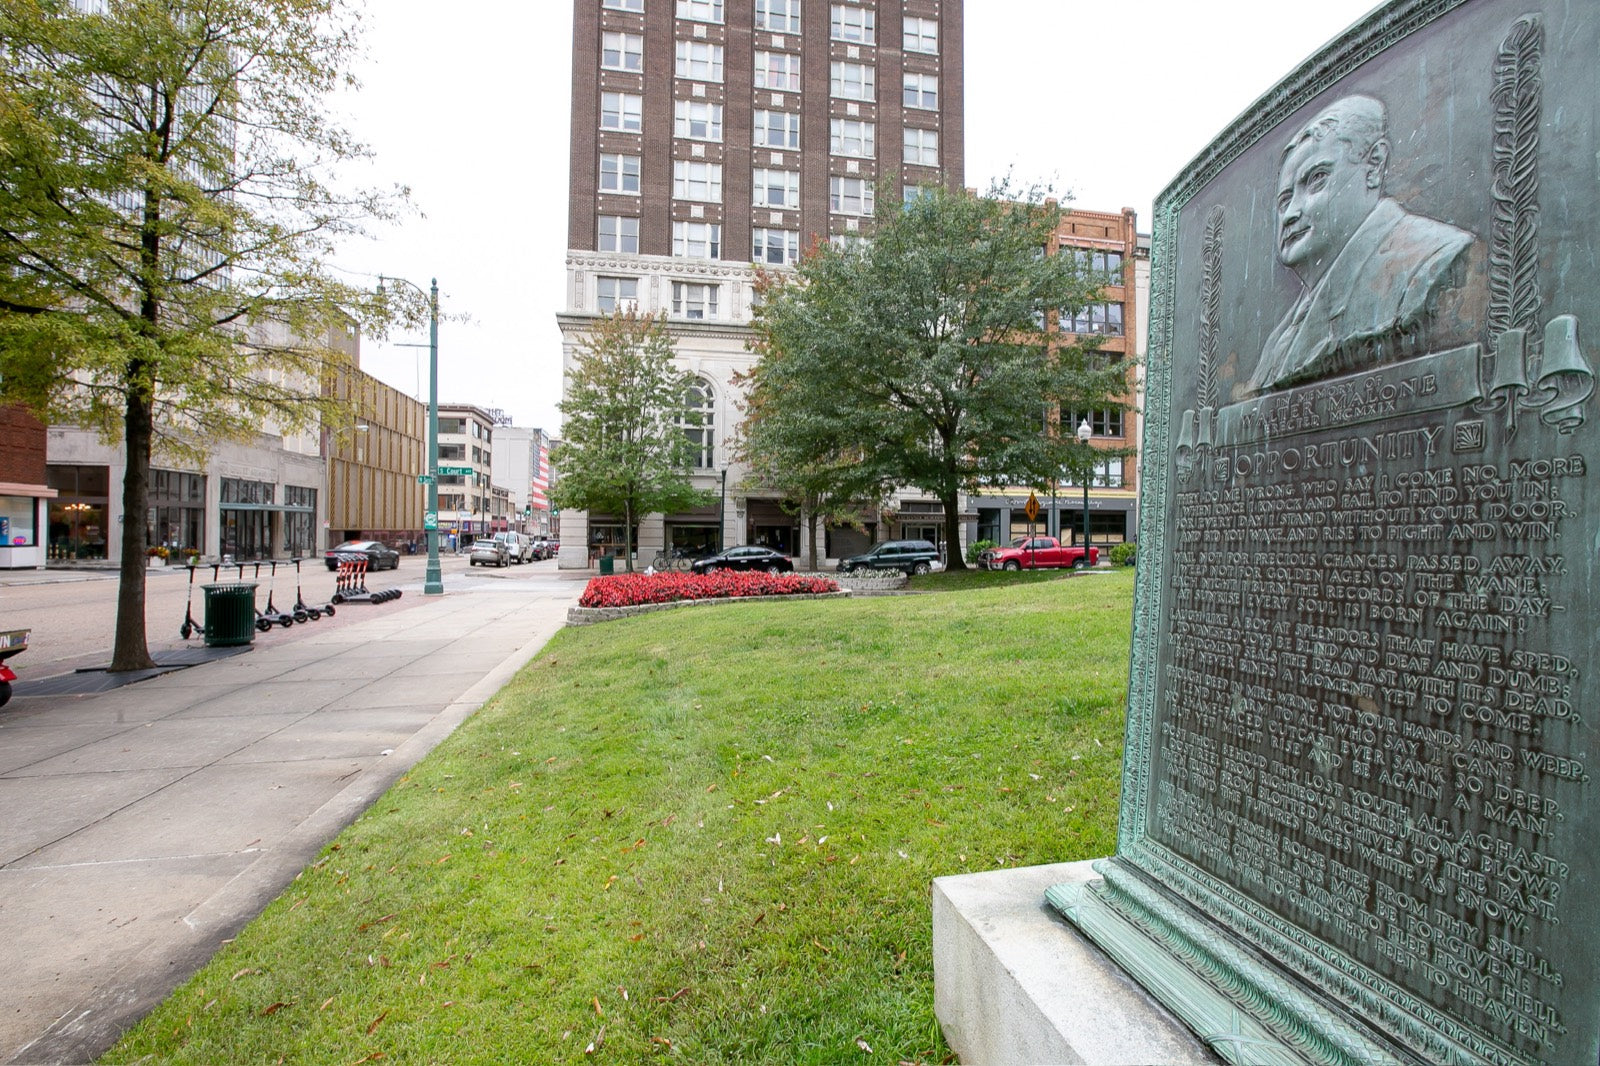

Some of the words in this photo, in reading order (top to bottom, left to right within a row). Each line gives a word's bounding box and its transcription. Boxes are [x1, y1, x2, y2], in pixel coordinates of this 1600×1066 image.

[1276, 395, 1289, 407] IN
[1297, 381, 1354, 402] MEMORY
[1365, 375, 1382, 389] OF
[1327, 374, 1437, 412] MALONE
[1329, 400, 1395, 422] MCMXIX
[446, 467, 463, 475] Court
[1301, 479, 1338, 495] WHO
[1345, 475, 1373, 491] SAY
[1381, 474, 1389, 489] I
[1396, 468, 1453, 487] COME
[1463, 464, 1496, 482] NO
[1509, 456, 1584, 479] MORE
[1279, 511, 1326, 525] STAND
[1331, 508, 1410, 523] WITHOUT
[1418, 504, 1479, 521] YOUR
[1304, 495, 1335, 510] AND
[1343, 492, 1375, 508] FAIL
[1379, 490, 1402, 506] TO
[1409, 486, 1457, 504] FIND
[1463, 482, 1512, 501] YOU
[1286, 527, 1319, 541] AND
[1323, 526, 1354, 540] RISE
[1360, 525, 1382, 540] TO
[1386, 524, 1443, 540] FIGHT
[1448, 522, 1495, 540] AND
[1323, 553, 1397, 569] CHANCES
[1406, 554, 1480, 572] PASSED
[1328, 569, 1371, 585] AGES
[1379, 571, 1405, 587] ON
[1416, 573, 1453, 589] THE
[1292, 582, 1319, 597] THE
[1326, 584, 1403, 604] RECORDS
[1415, 590, 1440, 606] OF
[1450, 592, 1488, 610] THE
[1297, 598, 1338, 615] SOUL
[1344, 602, 1360, 617] IS
[1369, 604, 1422, 624] BORN
[1435, 609, 1526, 635] AGAIN!
[1272, 620, 1290, 635] AT
[1295, 623, 1379, 648] SPLENDORS
[1387, 634, 1434, 656] THAT
[1442, 641, 1499, 665] HAVE
[1276, 635, 1291, 650] BE
[1296, 638, 1337, 658] BLIND
[1340, 645, 1378, 665] AND
[1387, 652, 1430, 674] DEAF
[1433, 659, 1479, 682] AND
[1281, 652, 1306, 669] THE
[1314, 657, 1352, 677] DEAD
[1358, 665, 1396, 686] PAST
[1403, 673, 1455, 697] WITH
[1462, 683, 1495, 705] ITS
[1283, 667, 1294, 682] A
[1301, 671, 1374, 699] MOMENT
[1381, 686, 1415, 708] YET
[1423, 694, 1451, 715] TO
[1273, 704, 1292, 722] TO
[1298, 710, 1325, 731] ALL
[1332, 719, 1376, 745] WHO
[1382, 732, 1419, 757] SAY
[1275, 690, 1319, 713] WRING
[1322, 701, 1351, 721] NOT
[1354, 709, 1398, 733] YOUR
[1402, 720, 1460, 748] HANDS
[1468, 736, 1514, 762] AND
[1309, 746, 1343, 770] AND
[1352, 759, 1370, 778] BE
[1379, 767, 1442, 802] AGAIN
[1451, 789, 1471, 811] A
[1340, 739, 1386, 767] EVER
[1392, 754, 1445, 785] SANK
[1458, 772, 1484, 796] SO
[1305, 771, 1343, 799] LOST
[1350, 787, 1409, 823] YOUTH
[1417, 811, 1456, 840] ALL
[1460, 826, 1569, 882] AGHAST?
[1305, 820, 1351, 854] PAGES
[1358, 842, 1415, 882] WHITE
[1422, 870, 1446, 896] AS
[1322, 811, 1405, 860] ARCHIVES
[1412, 846, 1437, 874] OF
[1445, 860, 1485, 894] THE
[1282, 836, 1325, 871] ROUSE
[1331, 859, 1370, 893] THEE
[1375, 880, 1427, 921] FROM
[1434, 907, 1479, 947] THY
[1292, 857, 1323, 886] SINS
[1330, 875, 1369, 909] MAY
[1376, 897, 1398, 924] BE
[1481, 853, 1561, 901] BLOW?
[1288, 888, 1331, 926] GUIDE
[1333, 912, 1366, 945] THY
[1374, 934, 1417, 974] FEET
[1425, 962, 1450, 992] TO
[1306, 881, 1353, 920] WINGS
[1361, 909, 1380, 934] TO
[1390, 924, 1426, 959] FLEE
[1434, 946, 1491, 994] FROM
